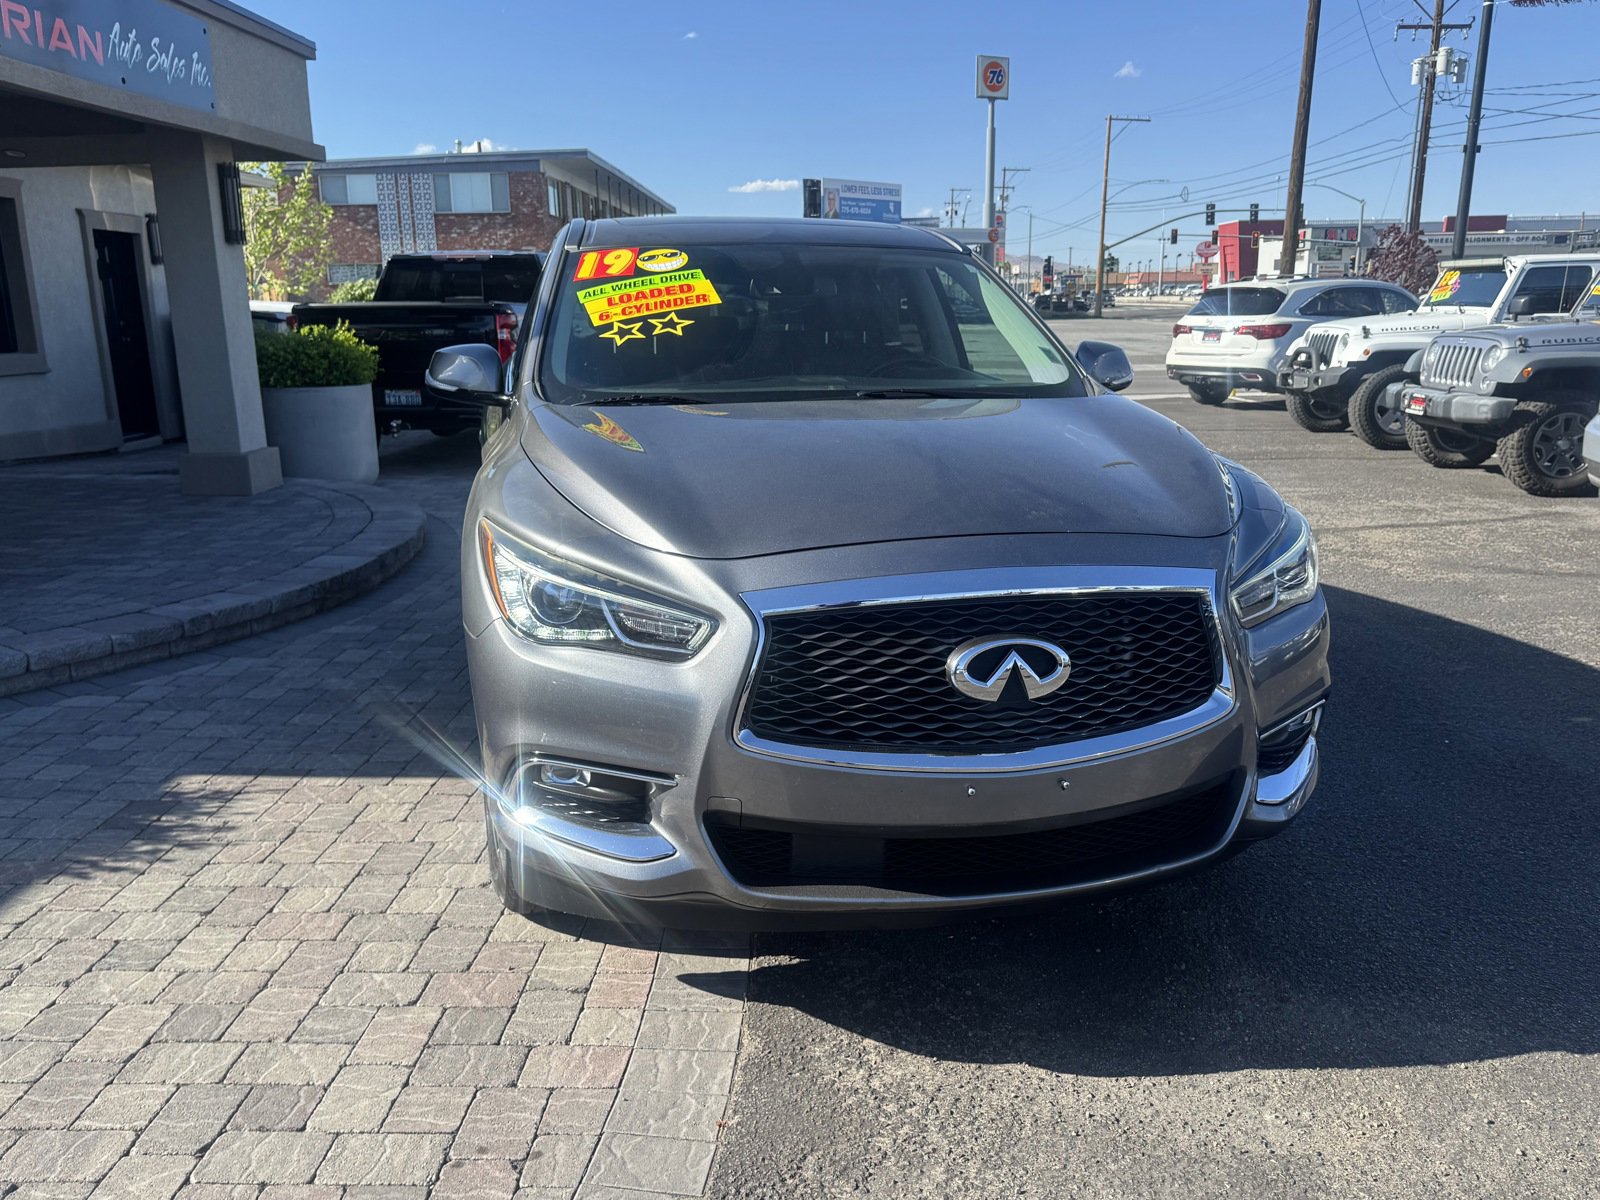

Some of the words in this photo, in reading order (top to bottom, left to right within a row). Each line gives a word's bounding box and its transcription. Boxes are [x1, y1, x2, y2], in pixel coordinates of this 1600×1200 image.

[107, 22, 143, 69] Auto
[147, 37, 186, 85] Sales
[190, 50, 212, 87] Inc.
[987, 68, 1005, 85] 76
[577, 249, 635, 279] 19
[582, 287, 609, 299] ALL
[611, 279, 657, 292] WHEEL
[659, 272, 699, 284] DRIVE
[607, 283, 695, 308] LOADED
[598, 294, 710, 322] 6-CYLINDER
